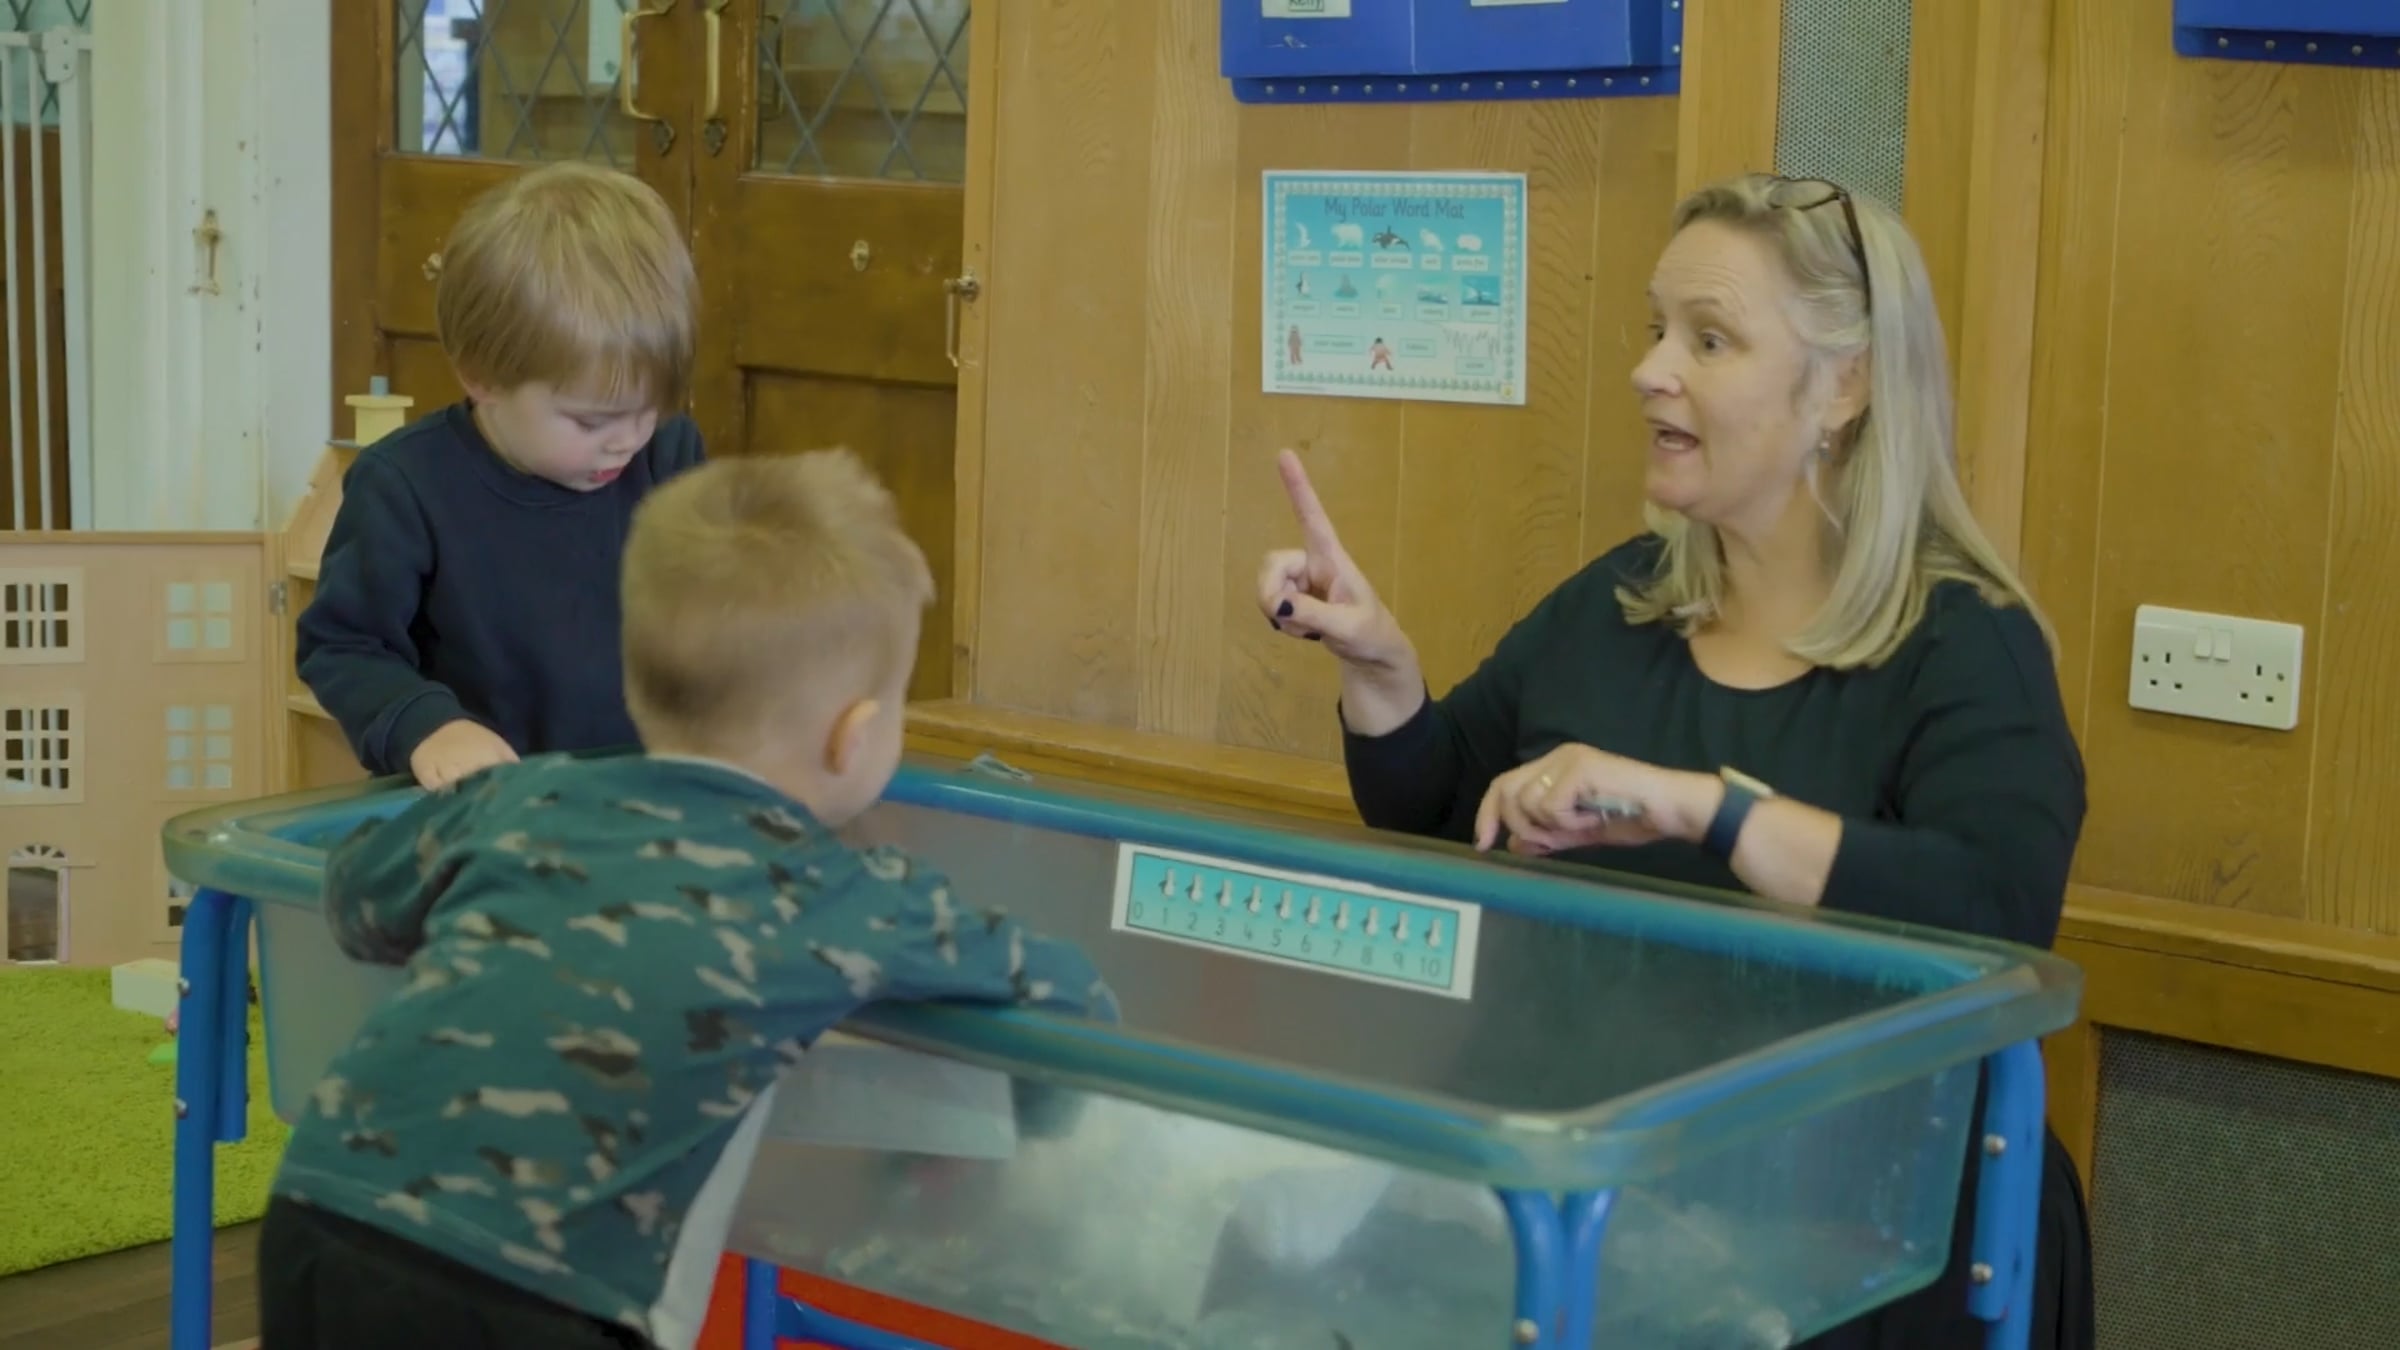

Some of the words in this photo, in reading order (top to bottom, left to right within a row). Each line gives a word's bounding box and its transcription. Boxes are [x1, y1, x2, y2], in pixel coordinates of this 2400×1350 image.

[1324, 198, 1346, 222] My
[1352, 199, 1387, 217] Polar
[1393, 200, 1429, 218] Word
[1435, 200, 1464, 218] Mat
[1132, 901, 1144, 920] 0
[1186, 913, 1198, 931] 2
[1216, 918, 1225, 936] 3
[1243, 924, 1253, 942] 4
[1271, 929, 1282, 948] 5
[1300, 935, 1311, 953] 6
[1332, 941, 1343, 957] 7
[1362, 947, 1372, 966] 8
[1393, 952, 1403, 970] 9
[1420, 956, 1440, 976] 10
